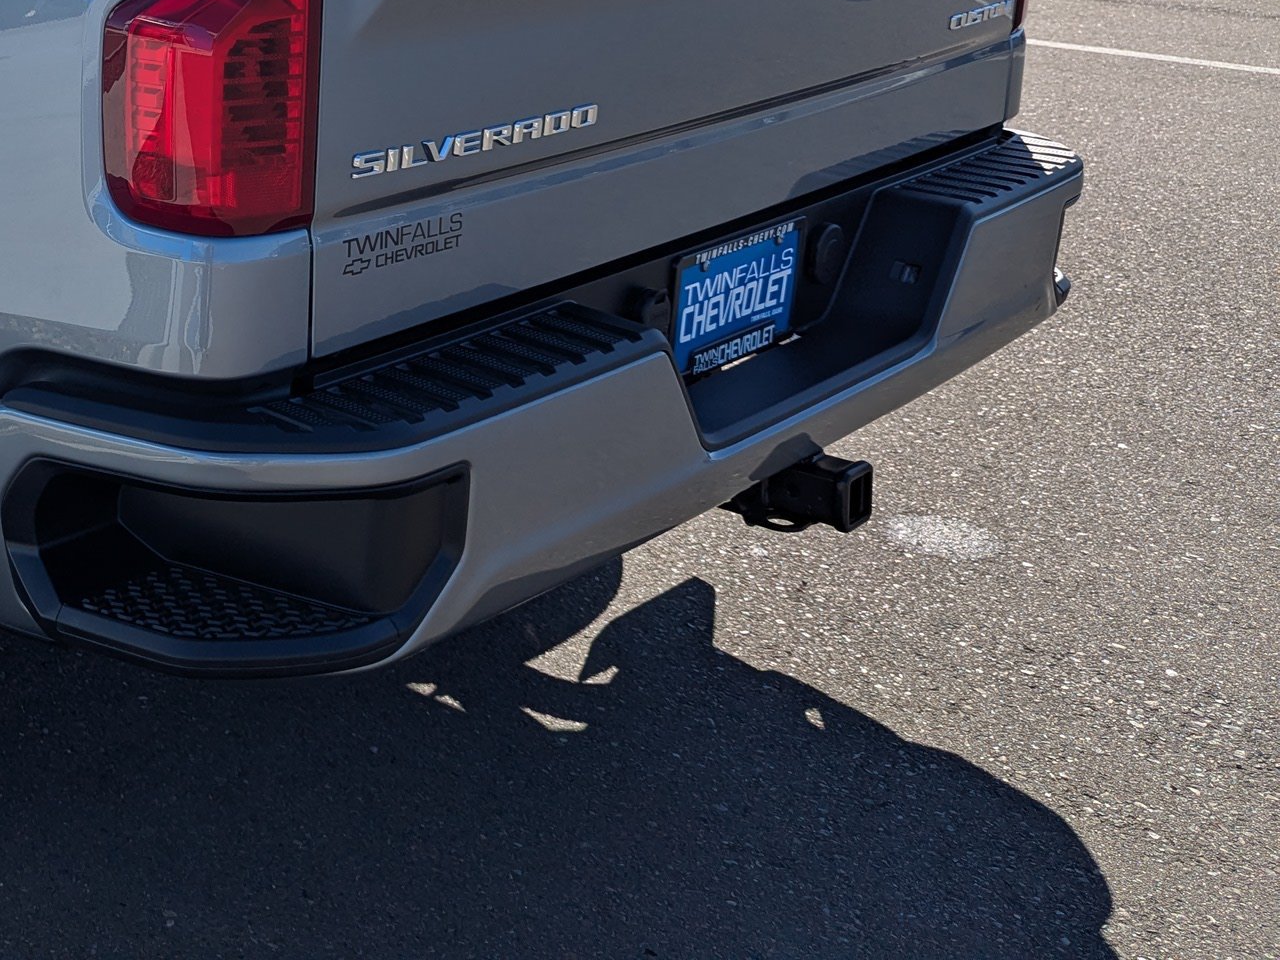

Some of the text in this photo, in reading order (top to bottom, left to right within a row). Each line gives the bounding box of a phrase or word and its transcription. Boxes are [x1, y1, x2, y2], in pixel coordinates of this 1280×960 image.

[351, 103, 598, 179] SILVERADO
[375, 234, 463, 268] CHEVROLET
[680, 268, 792, 343] CHEVROLET
[694, 346, 719, 365] TWIN
[718, 324, 776, 364] CHEVROLET
[693, 358, 718, 375] FALLS
